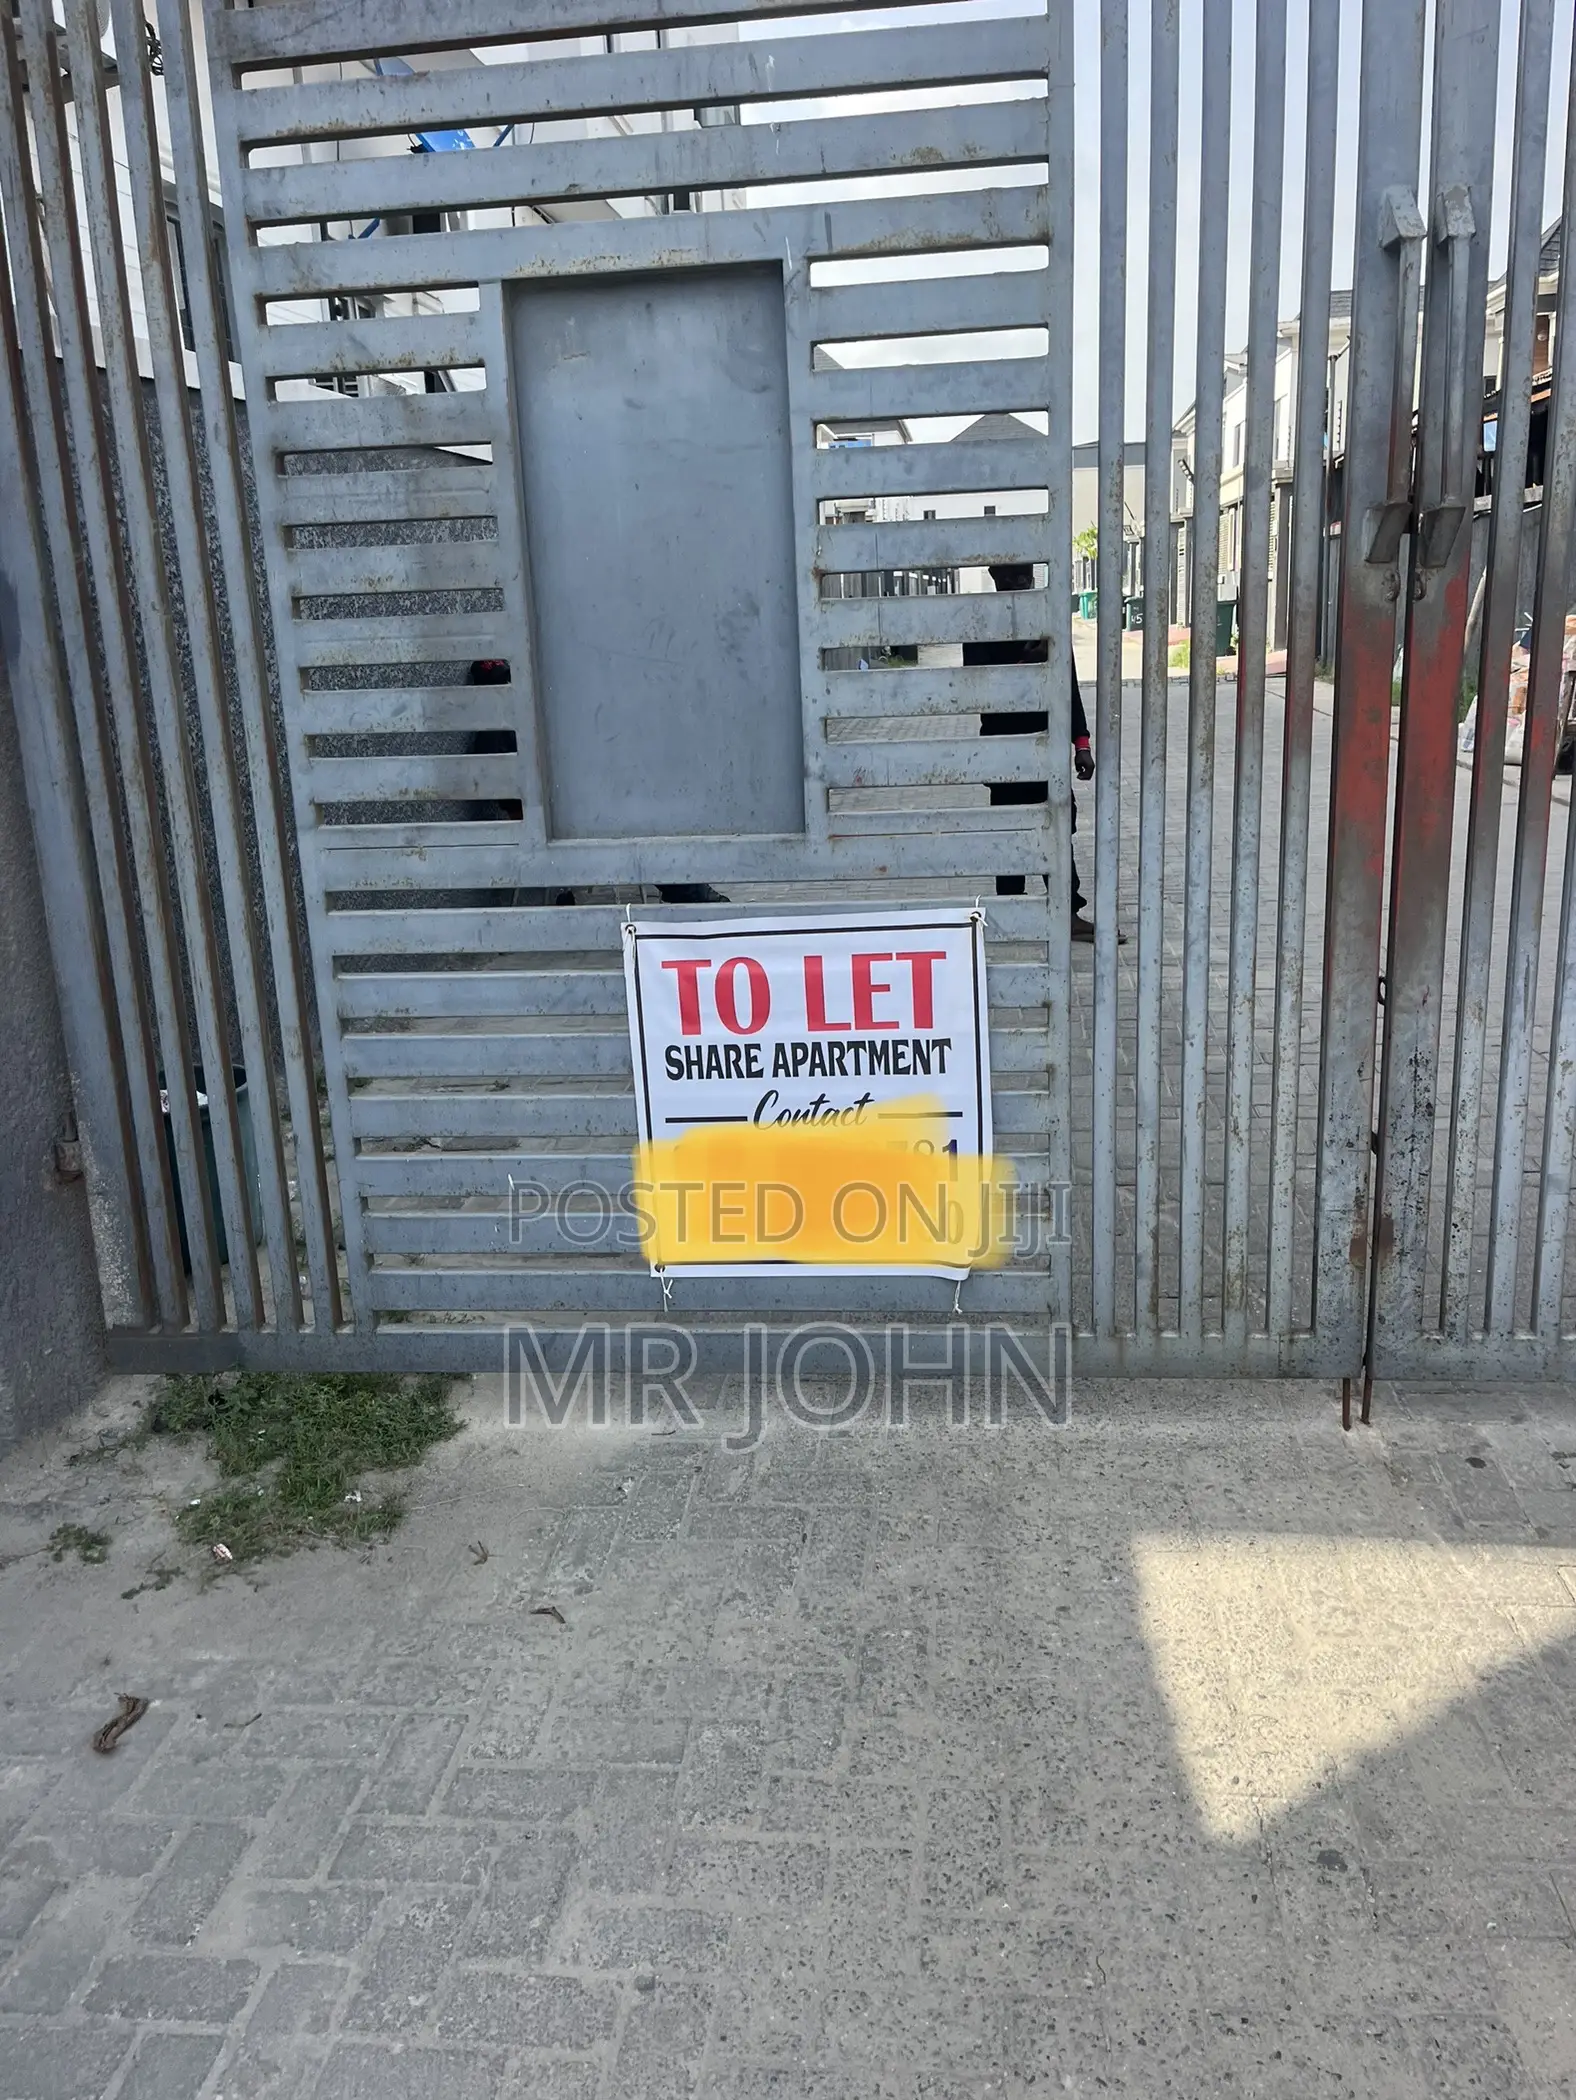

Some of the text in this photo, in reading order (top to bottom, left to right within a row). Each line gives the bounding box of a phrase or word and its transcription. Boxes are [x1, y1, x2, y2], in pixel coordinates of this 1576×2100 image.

[660, 950, 947, 1036] TO LET
[664, 1037, 953, 1081] SHARE APARTMENT
[752, 1088, 876, 1131] Contact
